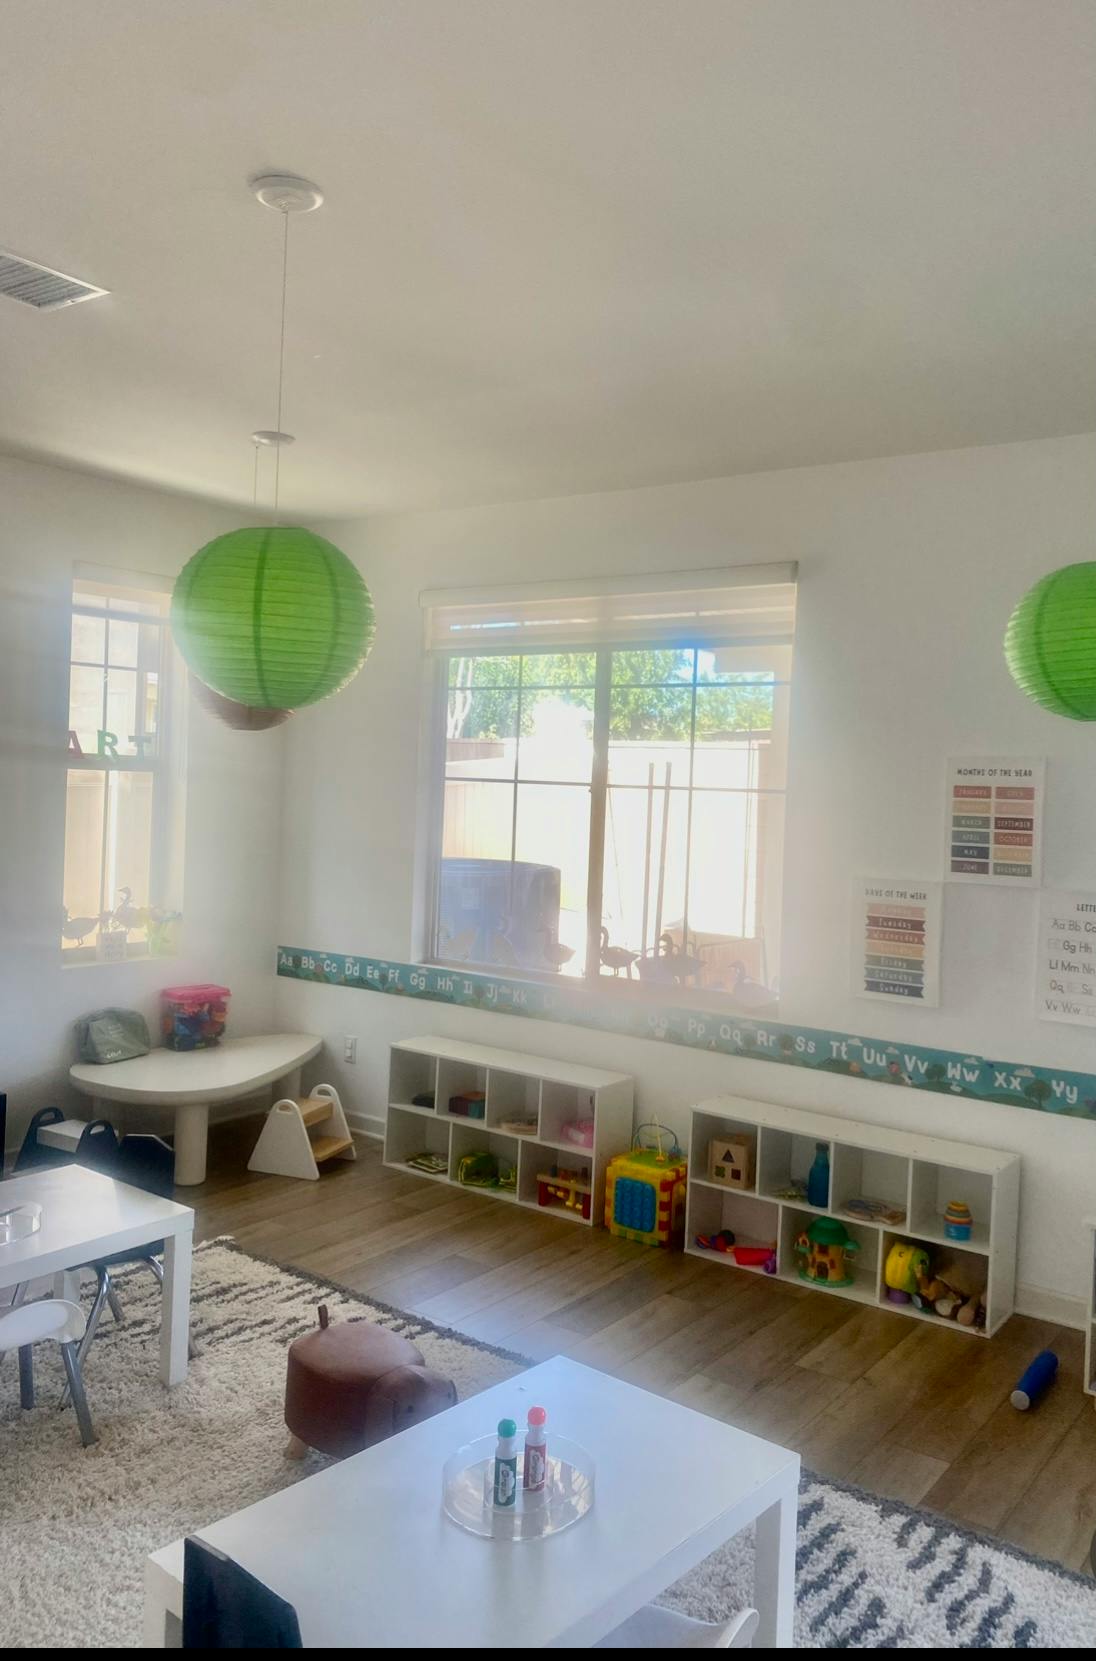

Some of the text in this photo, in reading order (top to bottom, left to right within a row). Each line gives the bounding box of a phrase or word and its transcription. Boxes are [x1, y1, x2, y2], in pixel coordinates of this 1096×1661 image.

[64, 730, 152, 760] ART
[1000, 769, 1012, 777] THE
[997, 820, 1031, 828] SEPTEMBER
[896, 890, 907, 899] THE
[910, 892, 927, 900] WEEK
[879, 918, 912, 929] Tuesday
[1051, 918, 1065, 930] Aa
[1068, 920, 1082, 932] Bb
[1062, 940, 1076, 954] Gg
[1079, 941, 1093, 954] Hh
[1061, 960, 1080, 973] Mm
[1082, 962, 1096, 975] Nn
[880, 983, 909, 995] Sunday
[1045, 1000, 1058, 1011] Vv
[1062, 1001, 1081, 1015] Ww
[280, 954, 293, 966] Aa
[301, 956, 315, 969] Bb
[323, 959, 337, 973] Cc
[345, 962, 360, 976] Dd
[366, 965, 380, 979] Ee
[388, 969, 400, 983] Ff
[410, 972, 426, 990] Gg
[437, 976, 453, 992] Hh
[486, 983, 498, 1002] Jj
[512, 987, 528, 1004] Kk
[687, 1018, 705, 1038] Pp
[719, 1024, 743, 1046] Qq
[757, 1030, 777, 1047] Rr
[794, 1035, 816, 1054] Ss
[829, 1040, 848, 1060] Tt
[862, 1046, 887, 1066] Uu
[903, 1053, 929, 1074] Vv
[947, 1062, 980, 1083] Ww
[994, 1071, 1022, 1091] Xx
[1051, 1079, 1078, 1104] Yy
